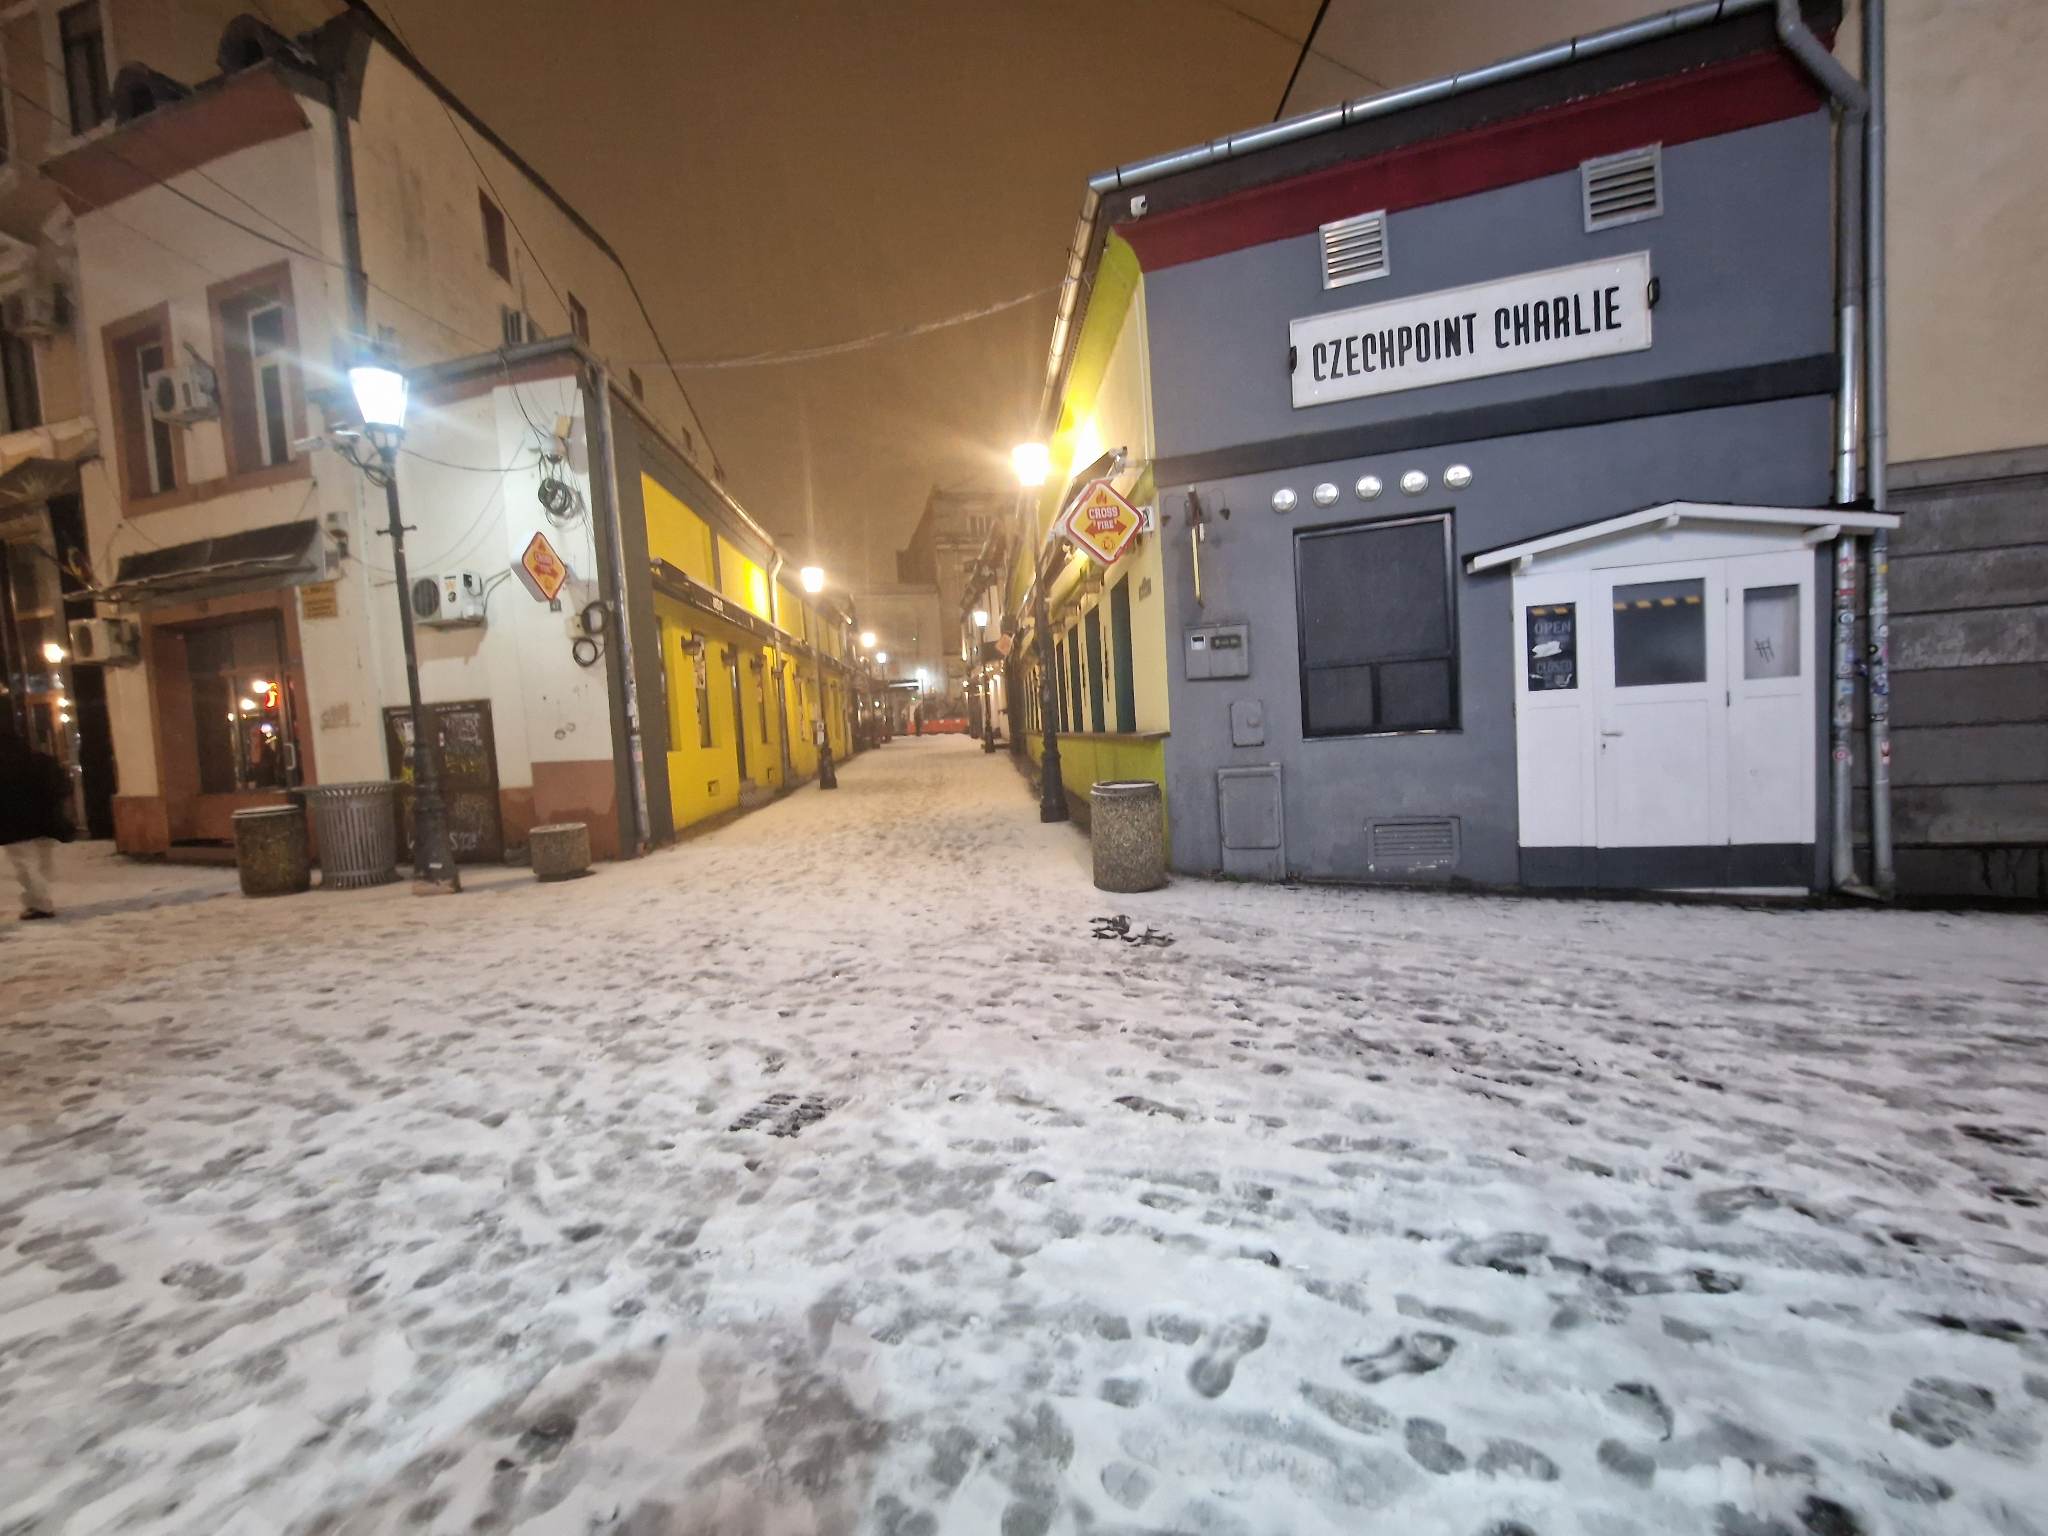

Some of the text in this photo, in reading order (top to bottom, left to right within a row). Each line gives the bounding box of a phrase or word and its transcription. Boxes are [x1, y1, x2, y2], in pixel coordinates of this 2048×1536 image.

[1312, 286, 1622, 382] CZECHPOINT CHARLIE
[1088, 506, 1119, 519] CROSS
[1096, 519, 1115, 530] FIRE
[1534, 620, 1571, 634] OPEN
